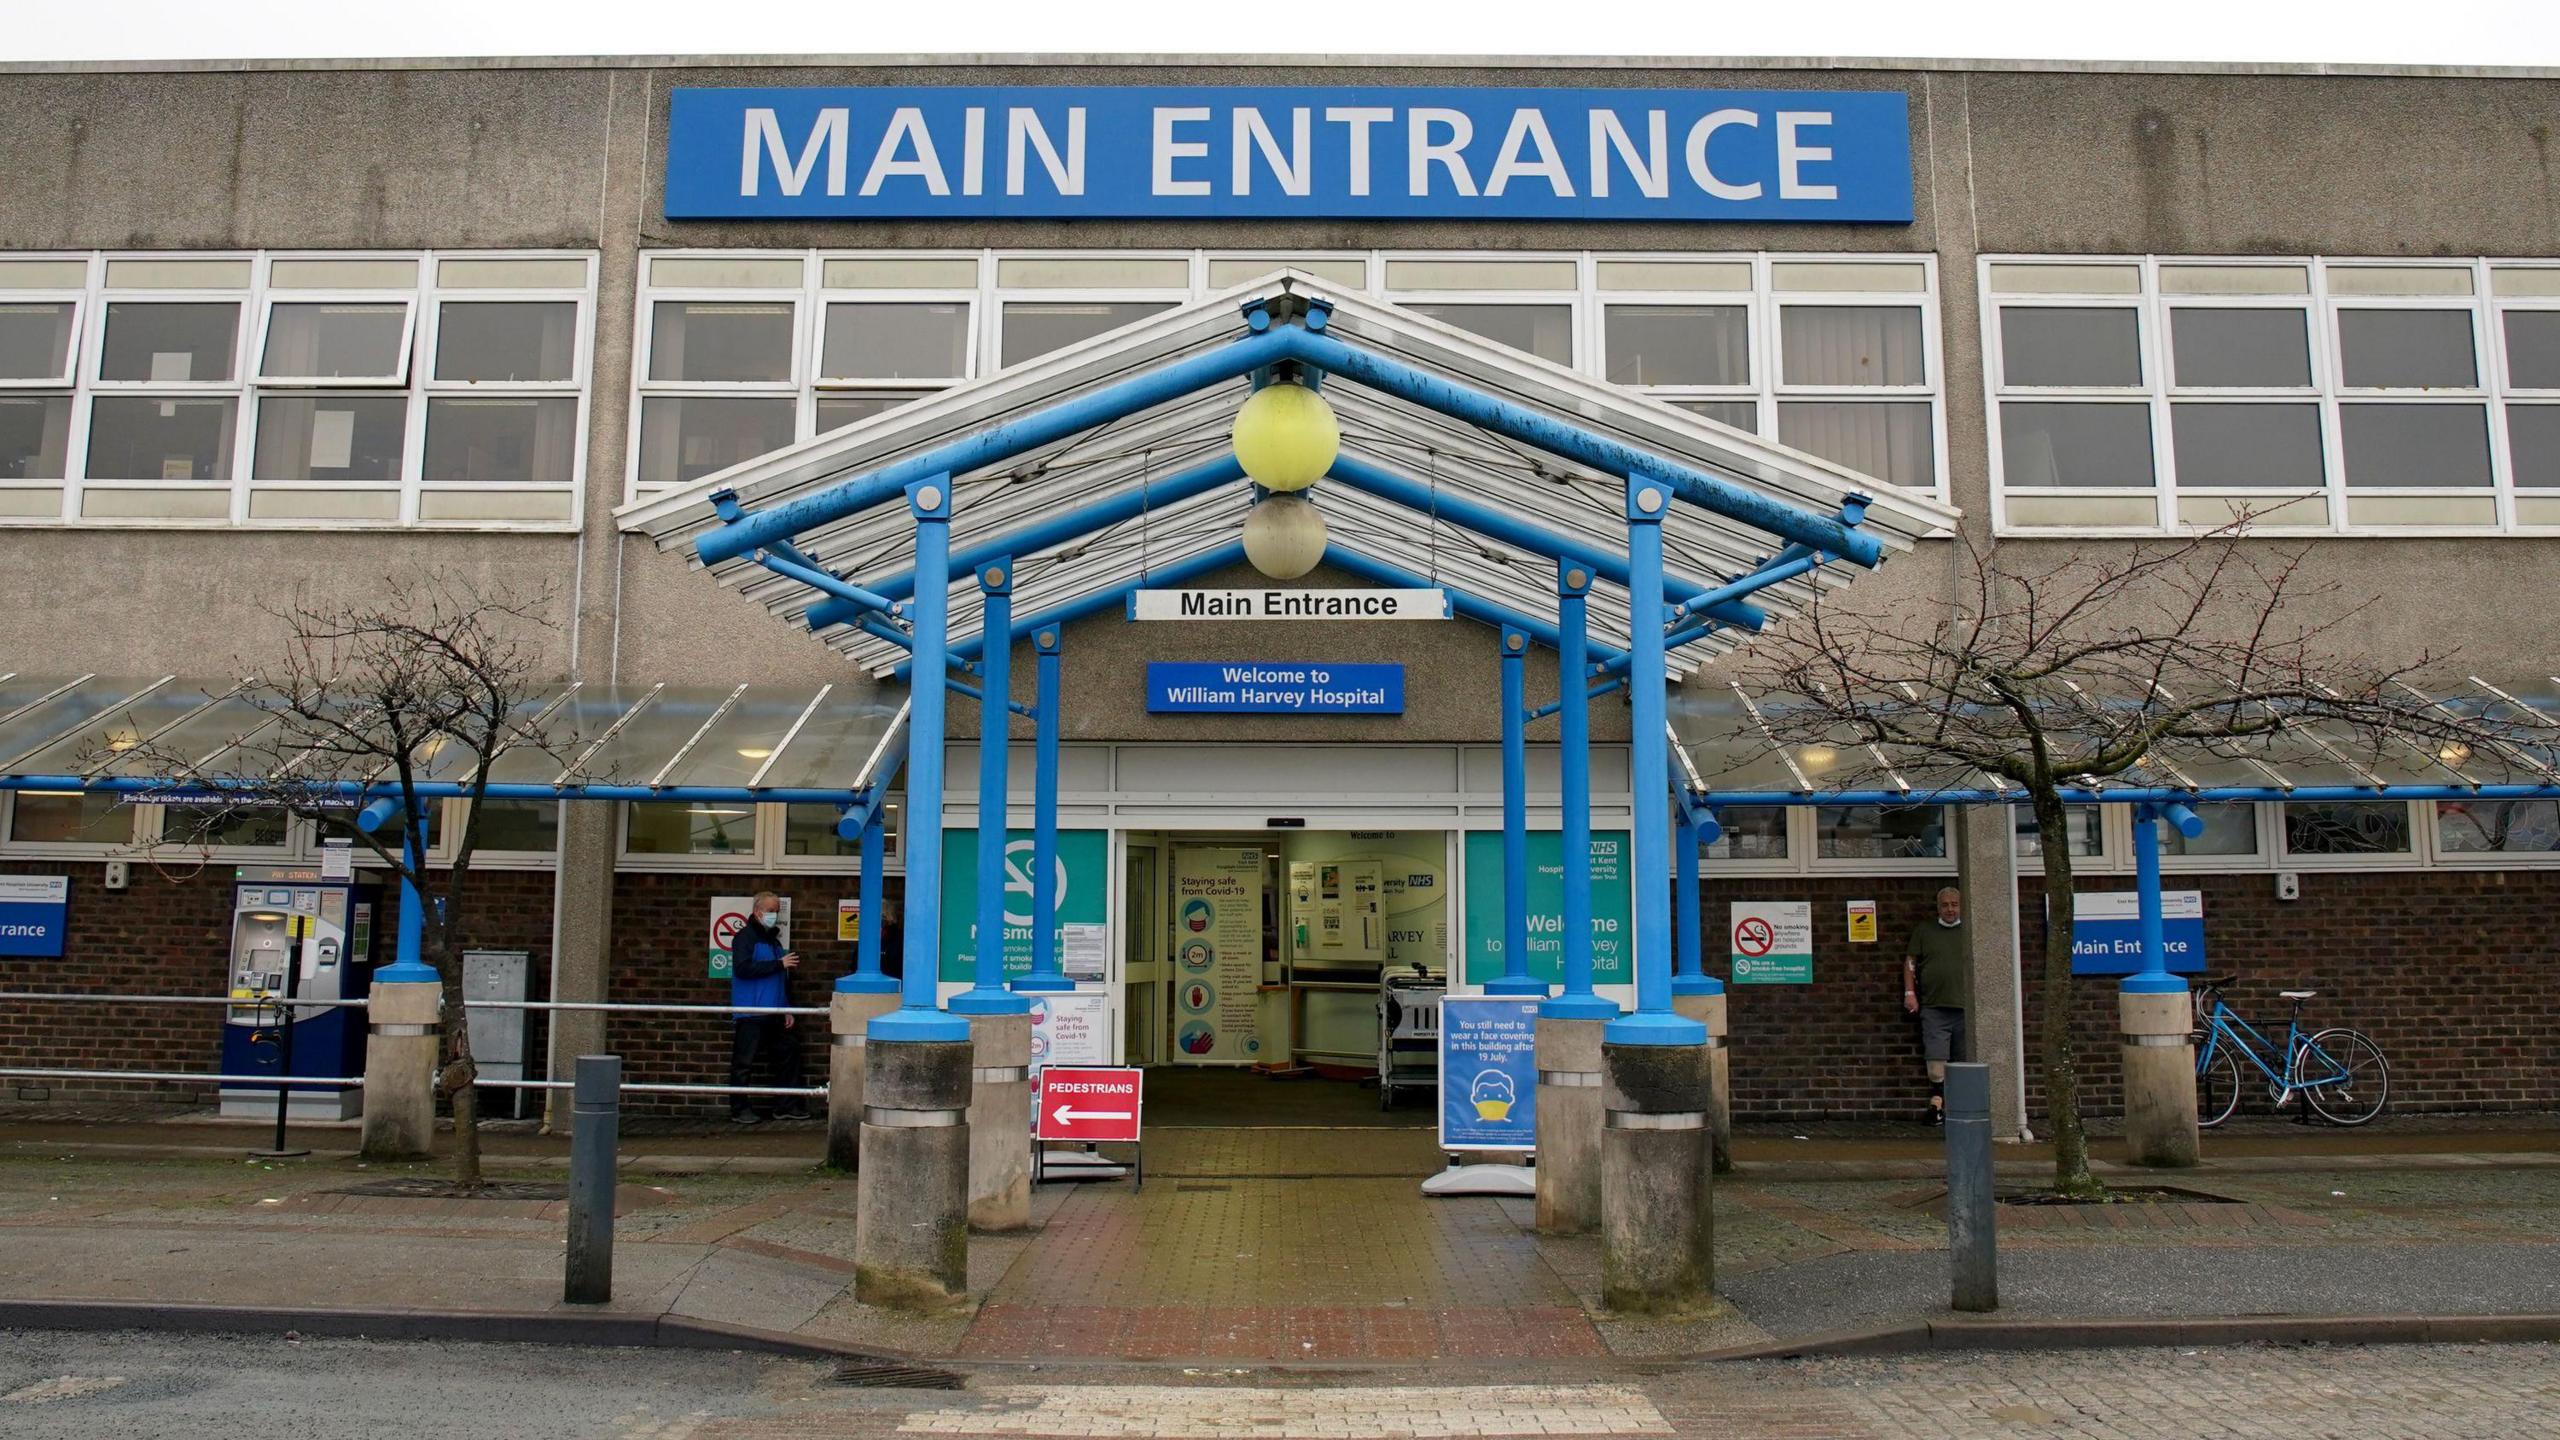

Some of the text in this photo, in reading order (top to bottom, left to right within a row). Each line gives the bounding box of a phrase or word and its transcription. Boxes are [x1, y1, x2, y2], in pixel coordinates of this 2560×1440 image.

[739, 106, 1839, 200] MAIN ENTRANCE
[1181, 592, 1398, 616] Main Entrance
[1223, 668, 1330, 683] Welcome to
[1167, 687, 1384, 708] William Harvey Hospital
[1350, 831, 1395, 840] Welcome to
[1539, 866, 1563, 874] Hospit
[1181, 876, 1237, 887] Staying safe
[1384, 879, 1405, 887] versity
[1409, 875, 1433, 886] NHS
[1181, 887, 1245, 895] from Covid-19
[1526, 915, 1618, 932] Welme
[0, 924, 46, 937] rance
[1388, 931, 1425, 942] RVEY
[1486, 937, 1619, 954] to lliam vey
[2072, 940, 2188, 955] Main Entnce
[1056, 1015, 1083, 1024] Staying
[1459, 1021, 1475, 1029] You
[1477, 1021, 1492, 1029] still
[1494, 1021, 1514, 1029] need
[1481, 1031, 1498, 1039] face
[1500, 1032, 1535, 1041] covering
[1451, 1042, 1534, 1052] in this building after
[1490, 1053, 1508, 1062] July.
[1049, 1083, 1134, 1094] PEDESTRIANS
